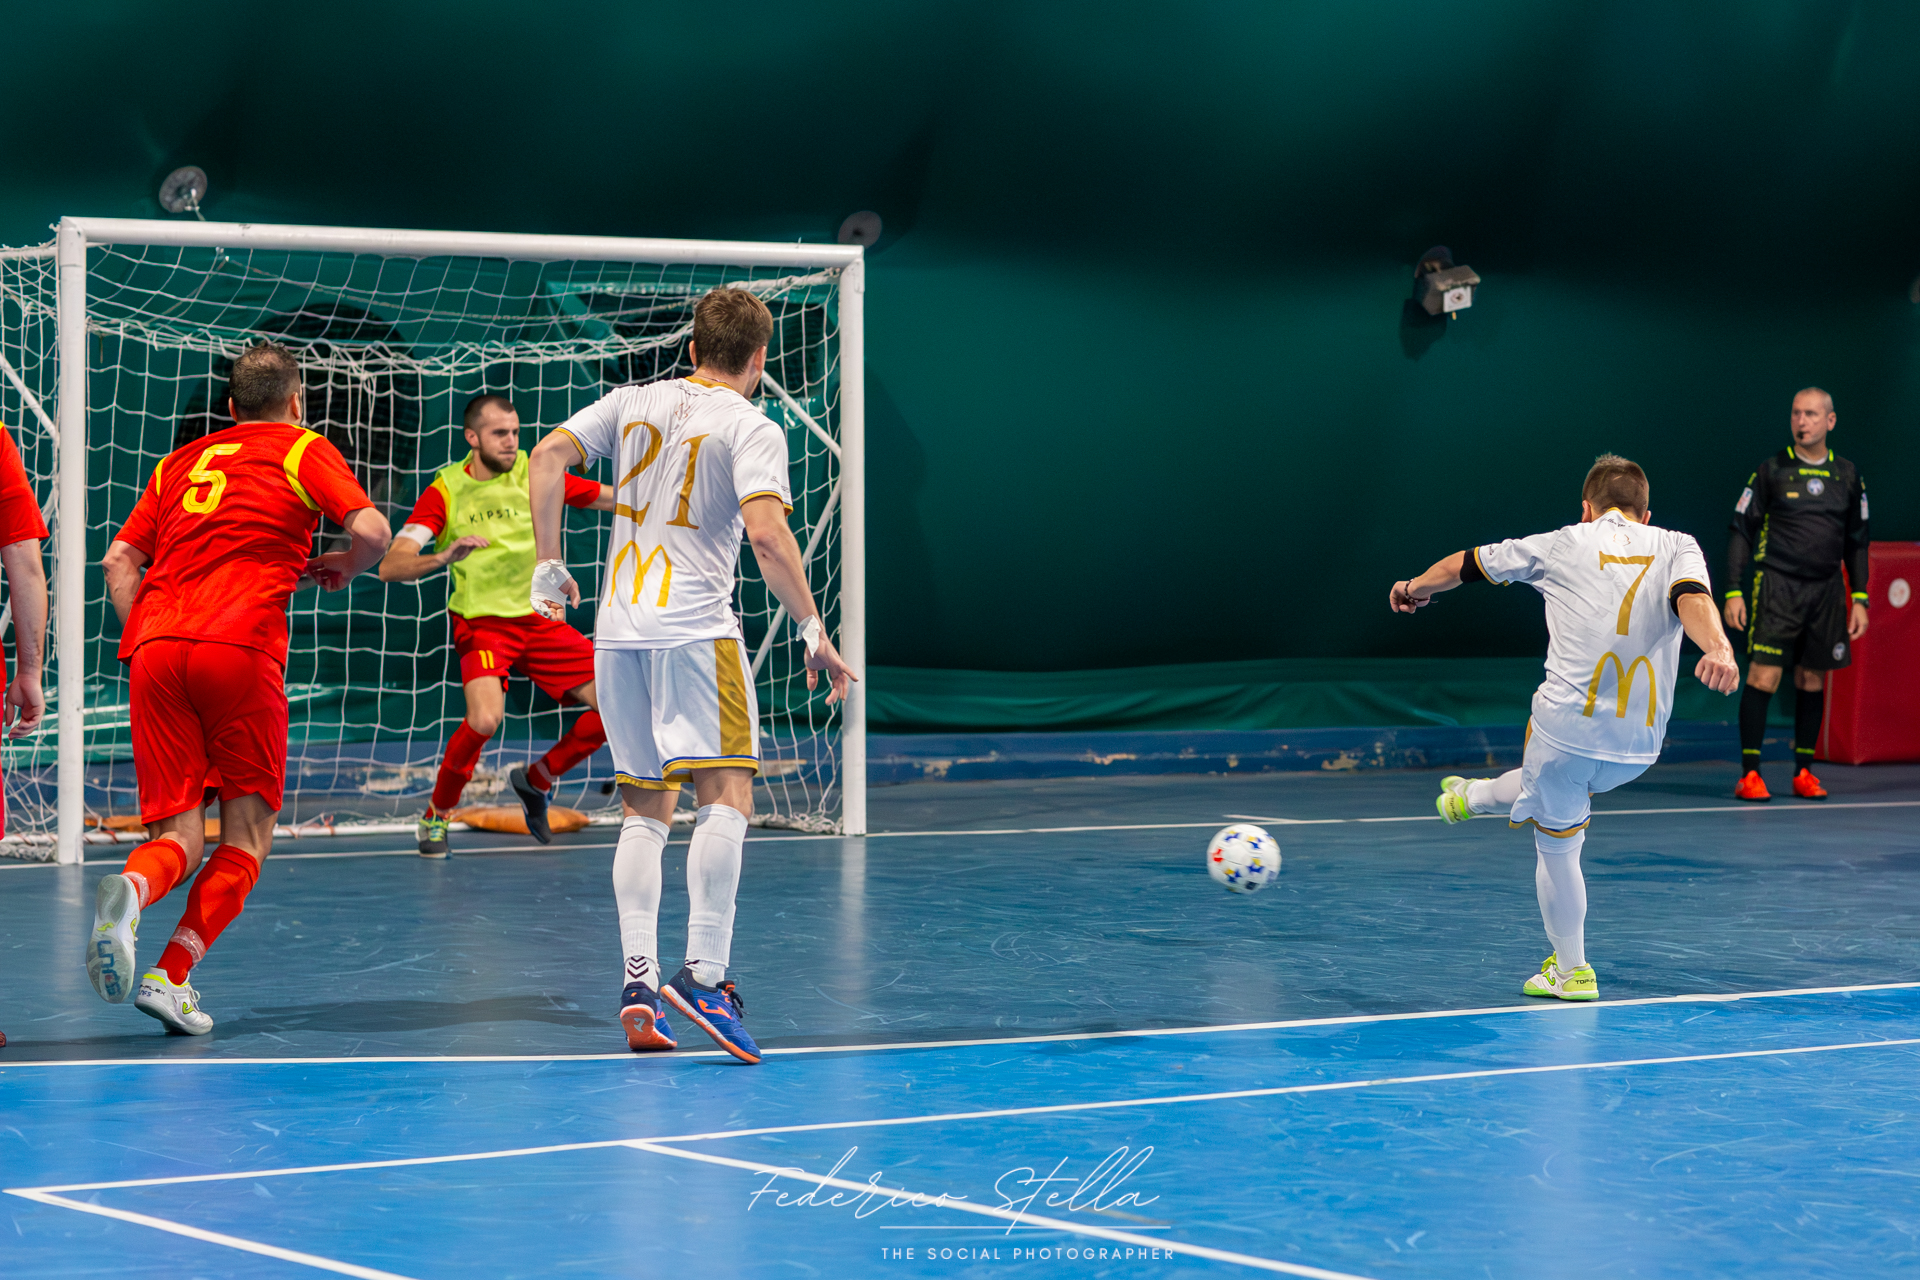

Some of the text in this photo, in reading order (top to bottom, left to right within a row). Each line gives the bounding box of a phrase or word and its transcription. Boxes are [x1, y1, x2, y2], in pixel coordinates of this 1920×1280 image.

[182, 443, 243, 514] 5
[614, 421, 710, 530] 21
[1599, 551, 1655, 636] 7
[479, 650, 495, 669] 11
